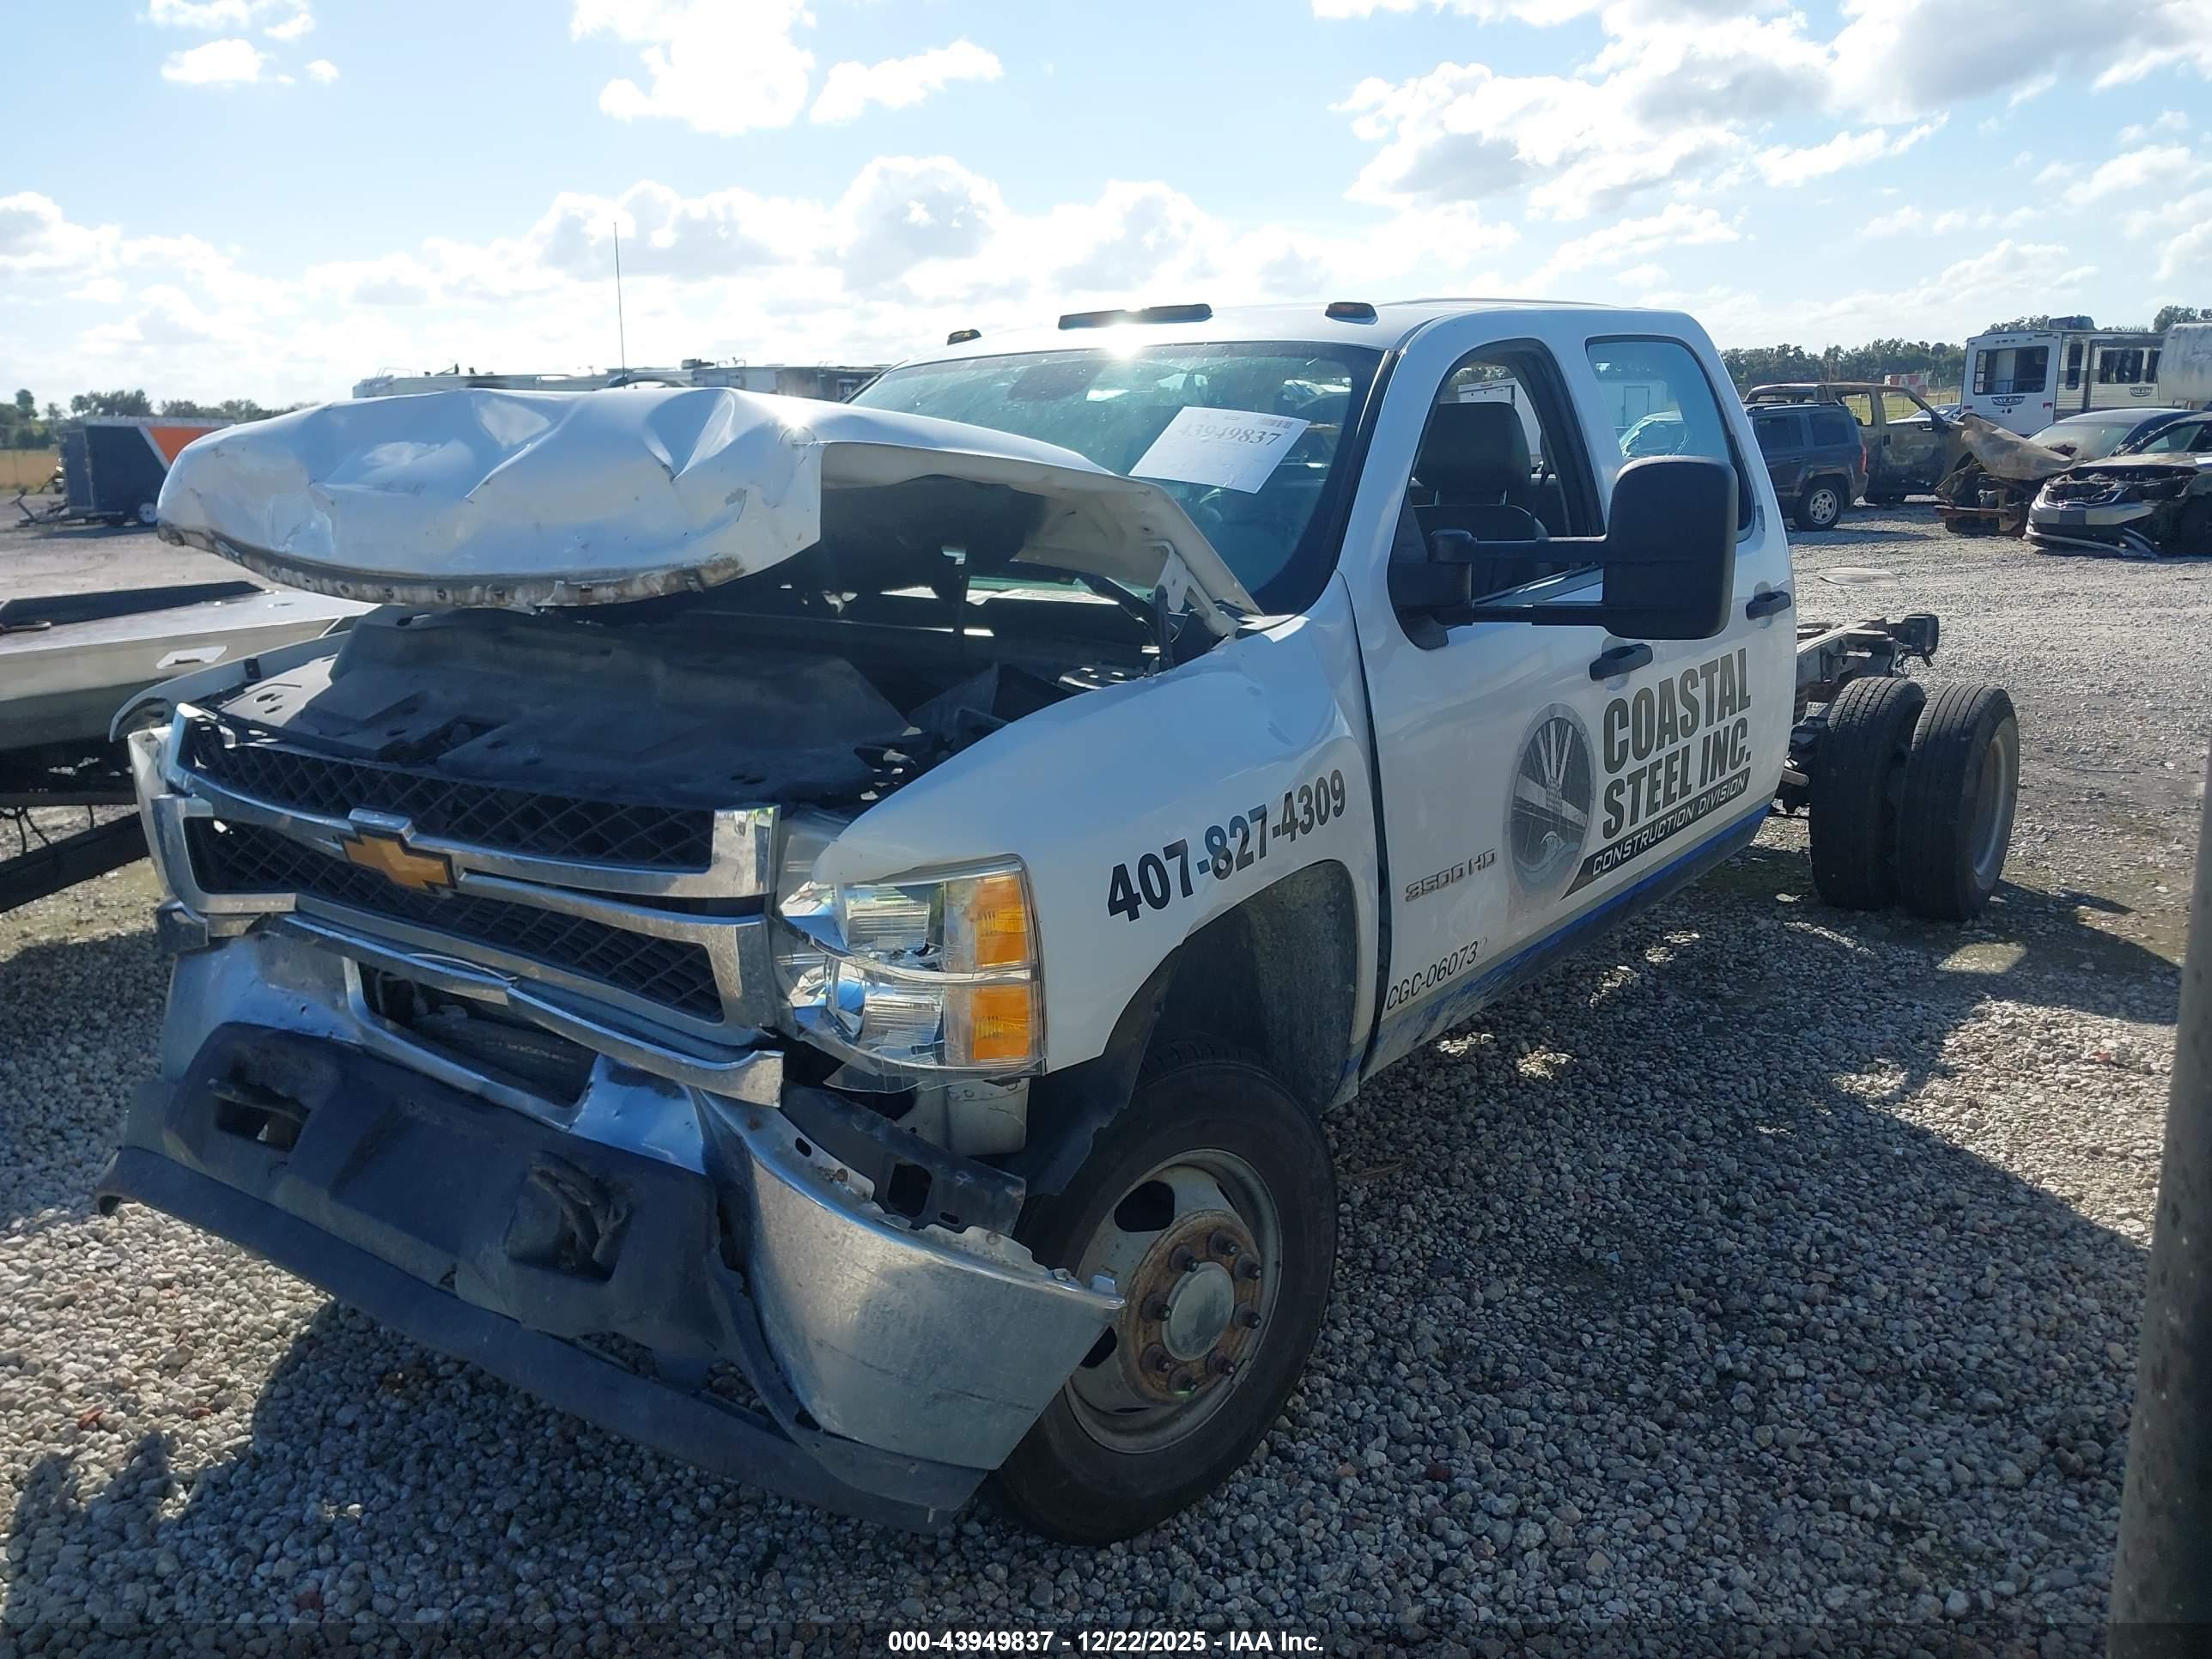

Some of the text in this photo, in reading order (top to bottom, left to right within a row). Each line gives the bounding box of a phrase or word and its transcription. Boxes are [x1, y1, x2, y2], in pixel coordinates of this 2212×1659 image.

[1179, 422, 1283, 447] 43949837
[1602, 647, 1752, 775] COASTAL
[1592, 773, 1747, 878] CONSTRUCTION DIVISION
[1602, 716, 1752, 841] STEEL INC.
[1107, 769, 1346, 923] 407-827-4309
[1468, 847, 1498, 877] HD
